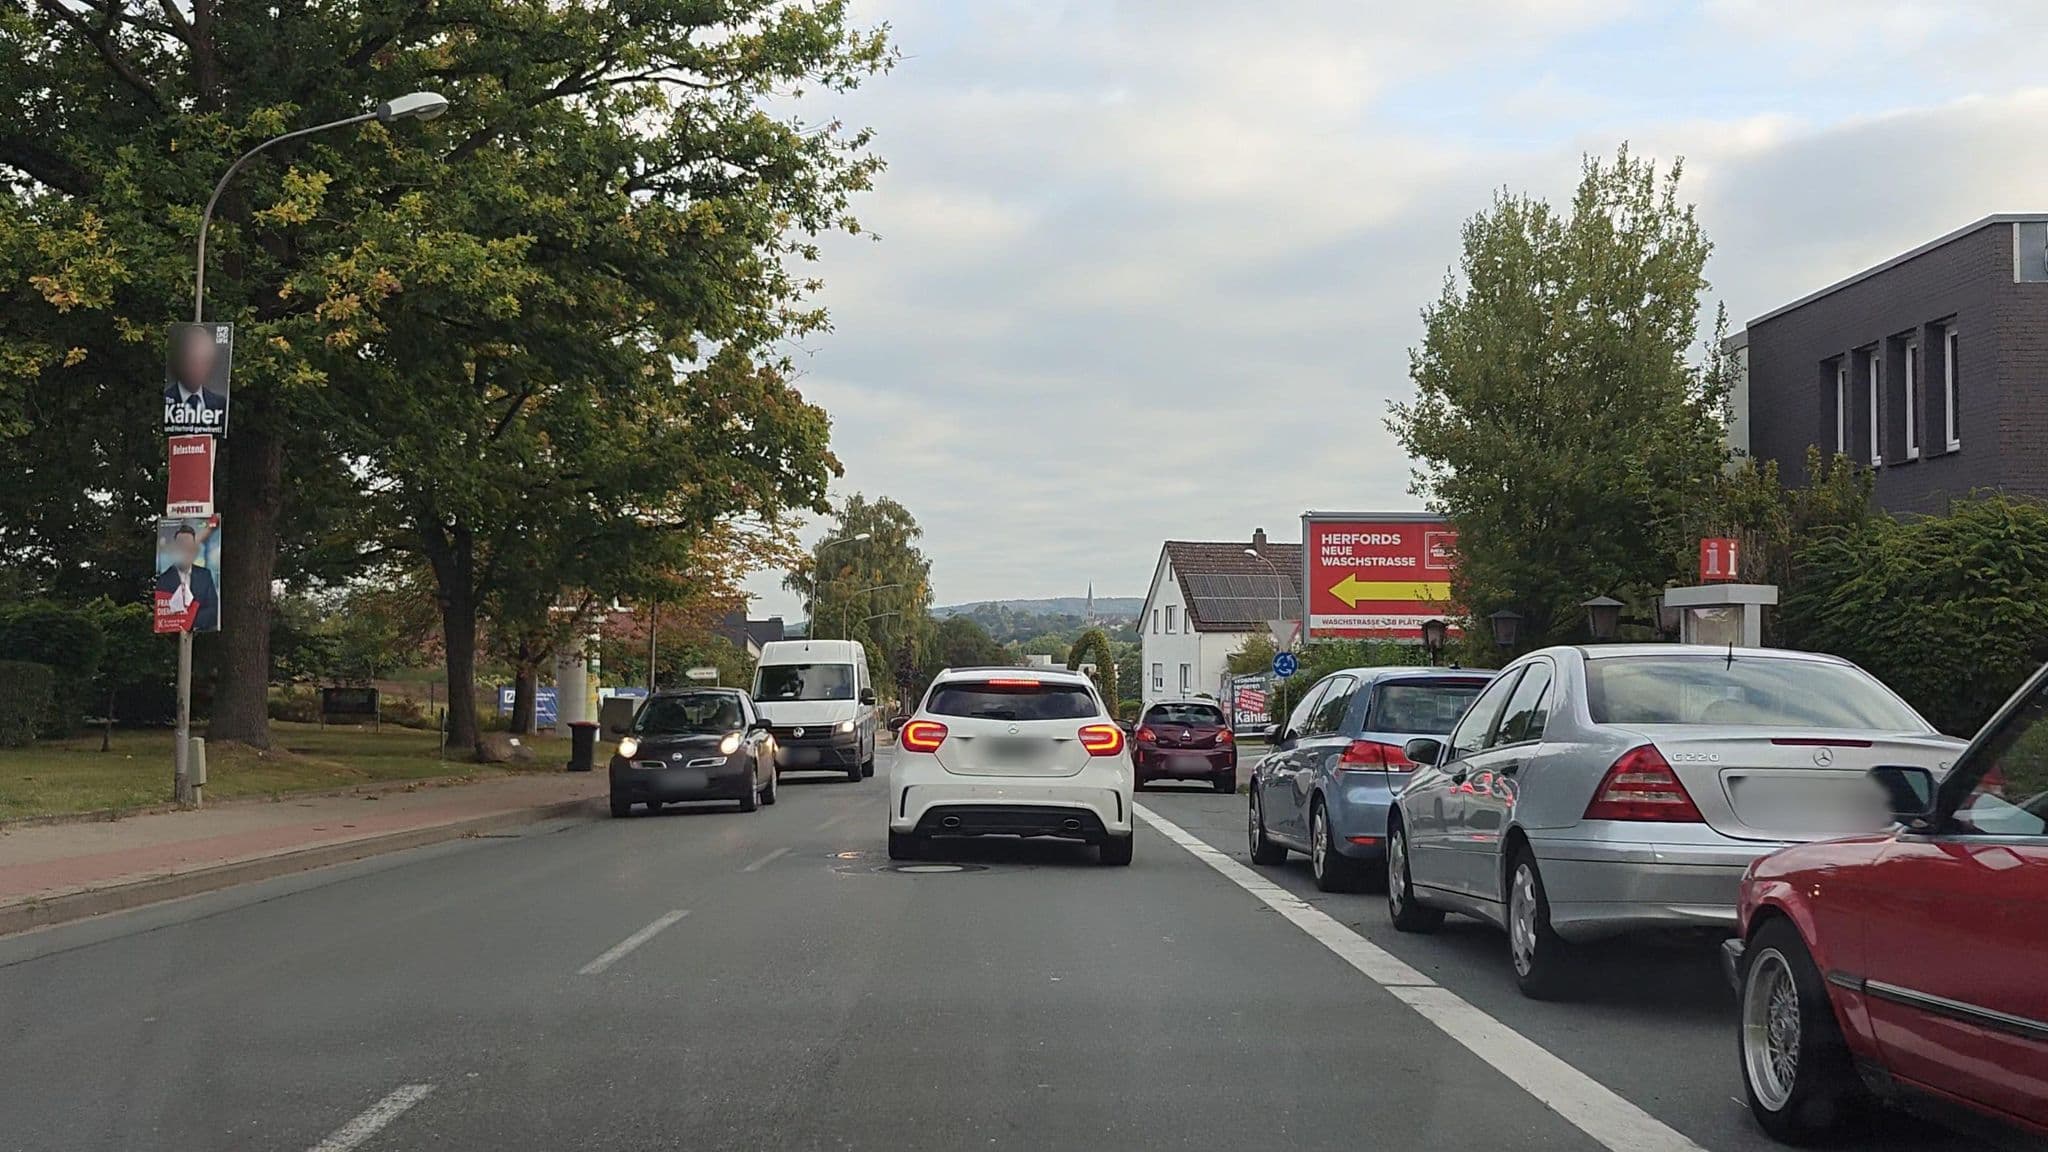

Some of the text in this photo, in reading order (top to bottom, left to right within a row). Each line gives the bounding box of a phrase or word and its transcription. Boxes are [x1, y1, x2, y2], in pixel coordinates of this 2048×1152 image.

[164, 403, 223, 425] Kähler
[1321, 533, 1402, 545] HERFORDS
[1321, 546, 1353, 556] NEUE
[1321, 557, 1416, 567] WASCHSTRASSE
[1322, 618, 1380, 626] WASCHSTRASSE
[1686, 752, 1720, 762] 220
